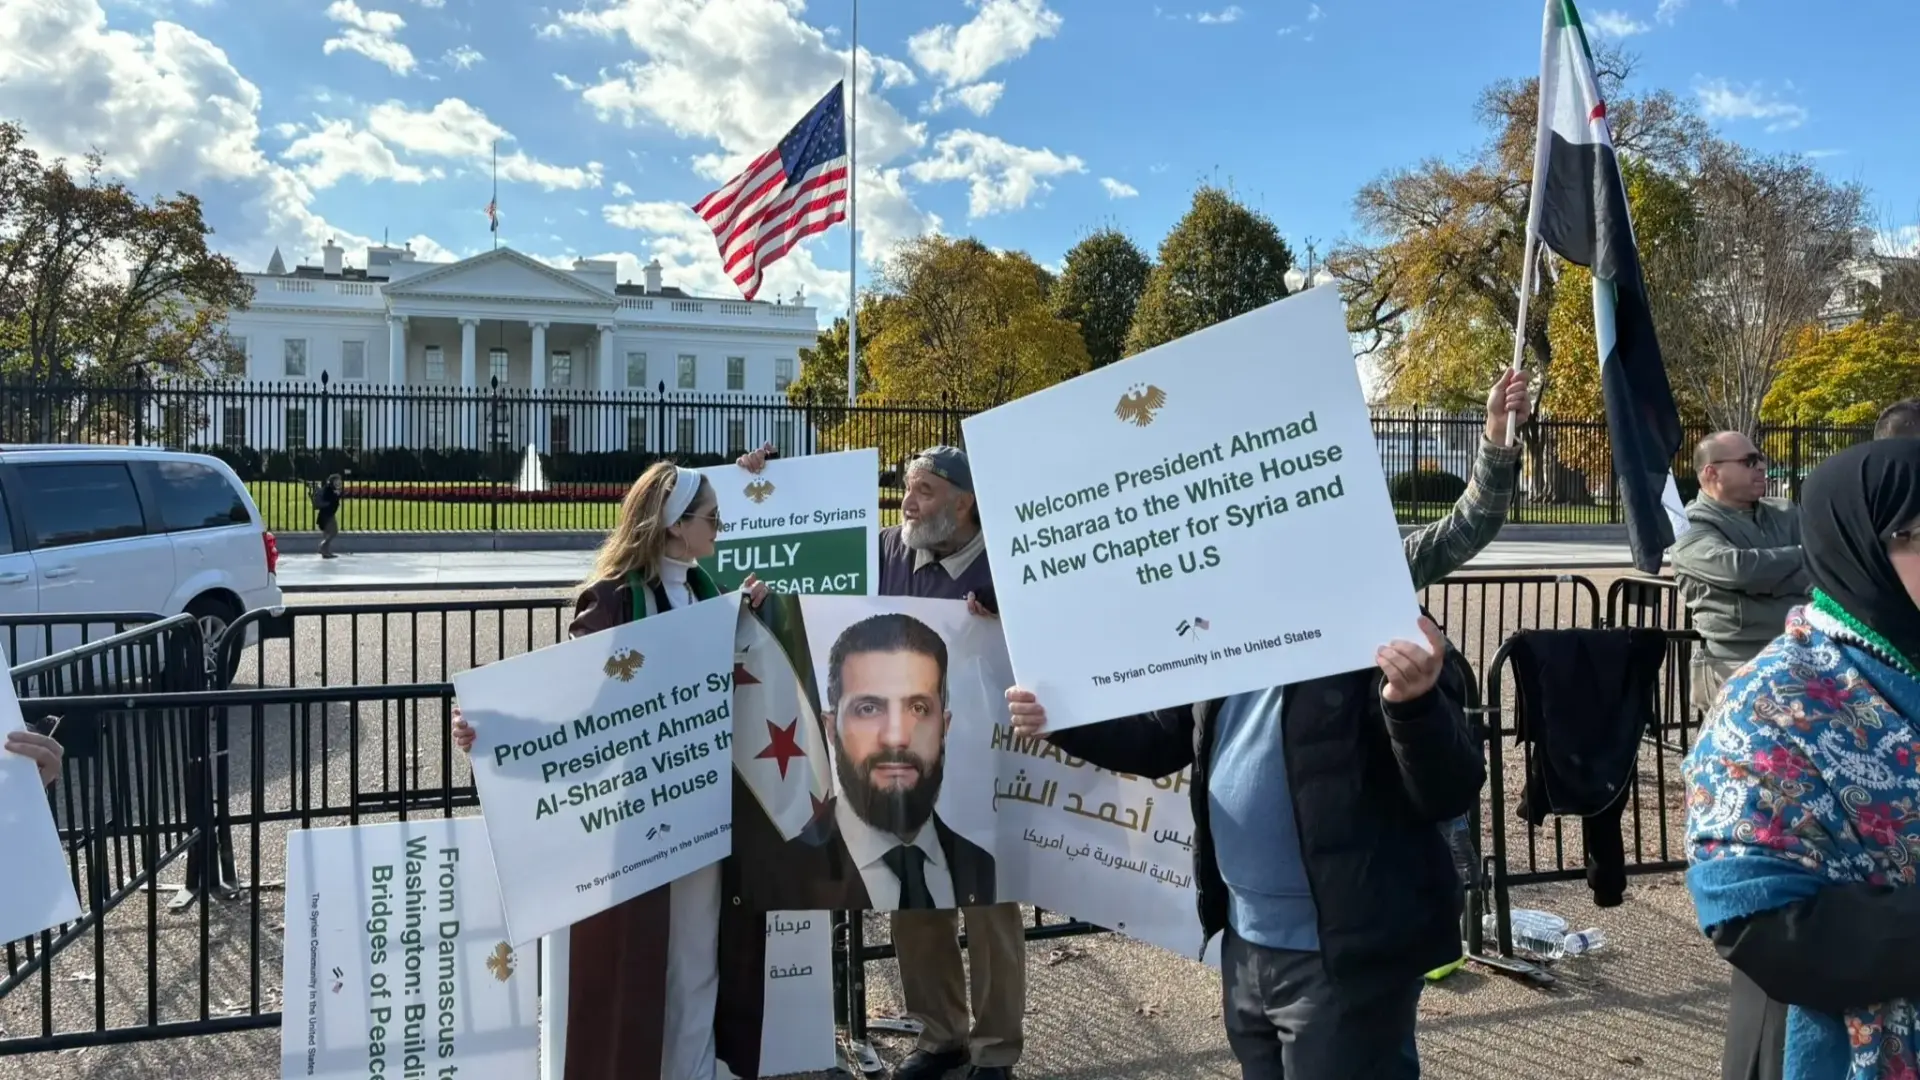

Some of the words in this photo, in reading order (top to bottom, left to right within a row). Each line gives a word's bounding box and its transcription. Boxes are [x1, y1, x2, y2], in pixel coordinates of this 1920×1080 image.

[1014, 482, 1110, 523] Welcome
[1115, 443, 1223, 493] President
[1230, 411, 1318, 458] Ahmad
[741, 516, 785, 531] Future
[788, 511, 809, 525] for
[813, 508, 867, 526] Syrians
[1011, 514, 1111, 557] Al-Sharaa
[1115, 506, 1138, 525] to
[1142, 494, 1180, 518] the
[1184, 471, 1254, 504] White
[1259, 445, 1343, 483] House
[1022, 564, 1038, 585] A
[1041, 553, 1087, 579] New
[1092, 525, 1181, 565] Chapter
[1186, 513, 1220, 538] for
[1226, 495, 1289, 530] Syria
[1296, 475, 1346, 508] and
[717, 542, 802, 573] FULLY
[1136, 562, 1173, 586] the
[1178, 545, 1221, 574] U.S
[764, 576, 814, 594] ESAR
[820, 572, 860, 592] ACT
[1091, 675, 1112, 688] The
[1113, 667, 1146, 684] Syrian
[1147, 653, 1208, 675] Community
[1210, 650, 1222, 661] in
[1223, 646, 1242, 658] the
[1244, 635, 1282, 654] United
[1284, 628, 1322, 645] States
[494, 724, 568, 767] Proud
[573, 692, 667, 740] Moment
[671, 680, 701, 704] for
[706, 672, 735, 696] Sy
[541, 731, 651, 784] President
[657, 700, 731, 743] Ahmad
[535, 765, 648, 821] Al-Sharaa
[651, 742, 710, 774] Visits
[713, 729, 733, 752] th
[579, 798, 646, 834] White
[650, 769, 719, 807] House
[1063, 793, 1154, 833] أحمد
[1023, 828, 1064, 849] أمريكا
[1066, 843, 1090, 861] في
[439, 848, 459, 913] From
[575, 882, 592, 894] The
[593, 870, 621, 886] Syrian
[622, 850, 668, 875] Community
[670, 846, 679, 855] in
[679, 840, 692, 851] the
[693, 827, 719, 844] United
[1094, 847, 1147, 875] السورية
[1150, 864, 1192, 889] الجالية
[311, 892, 320, 908] The
[366, 865, 393, 965] Bridges
[401, 835, 427, 996] Washington:
[309, 910, 320, 938] Syrian
[308, 940, 319, 989] Community
[769, 963, 812, 979] صفحة
[309, 991, 317, 1000] in
[370, 973, 392, 999] of
[438, 921, 460, 1059] Damascus
[308, 1001, 317, 1016] the
[308, 1017, 317, 1046] United
[403, 1003, 427, 1080] Buildi
[307, 1048, 317, 1076] States
